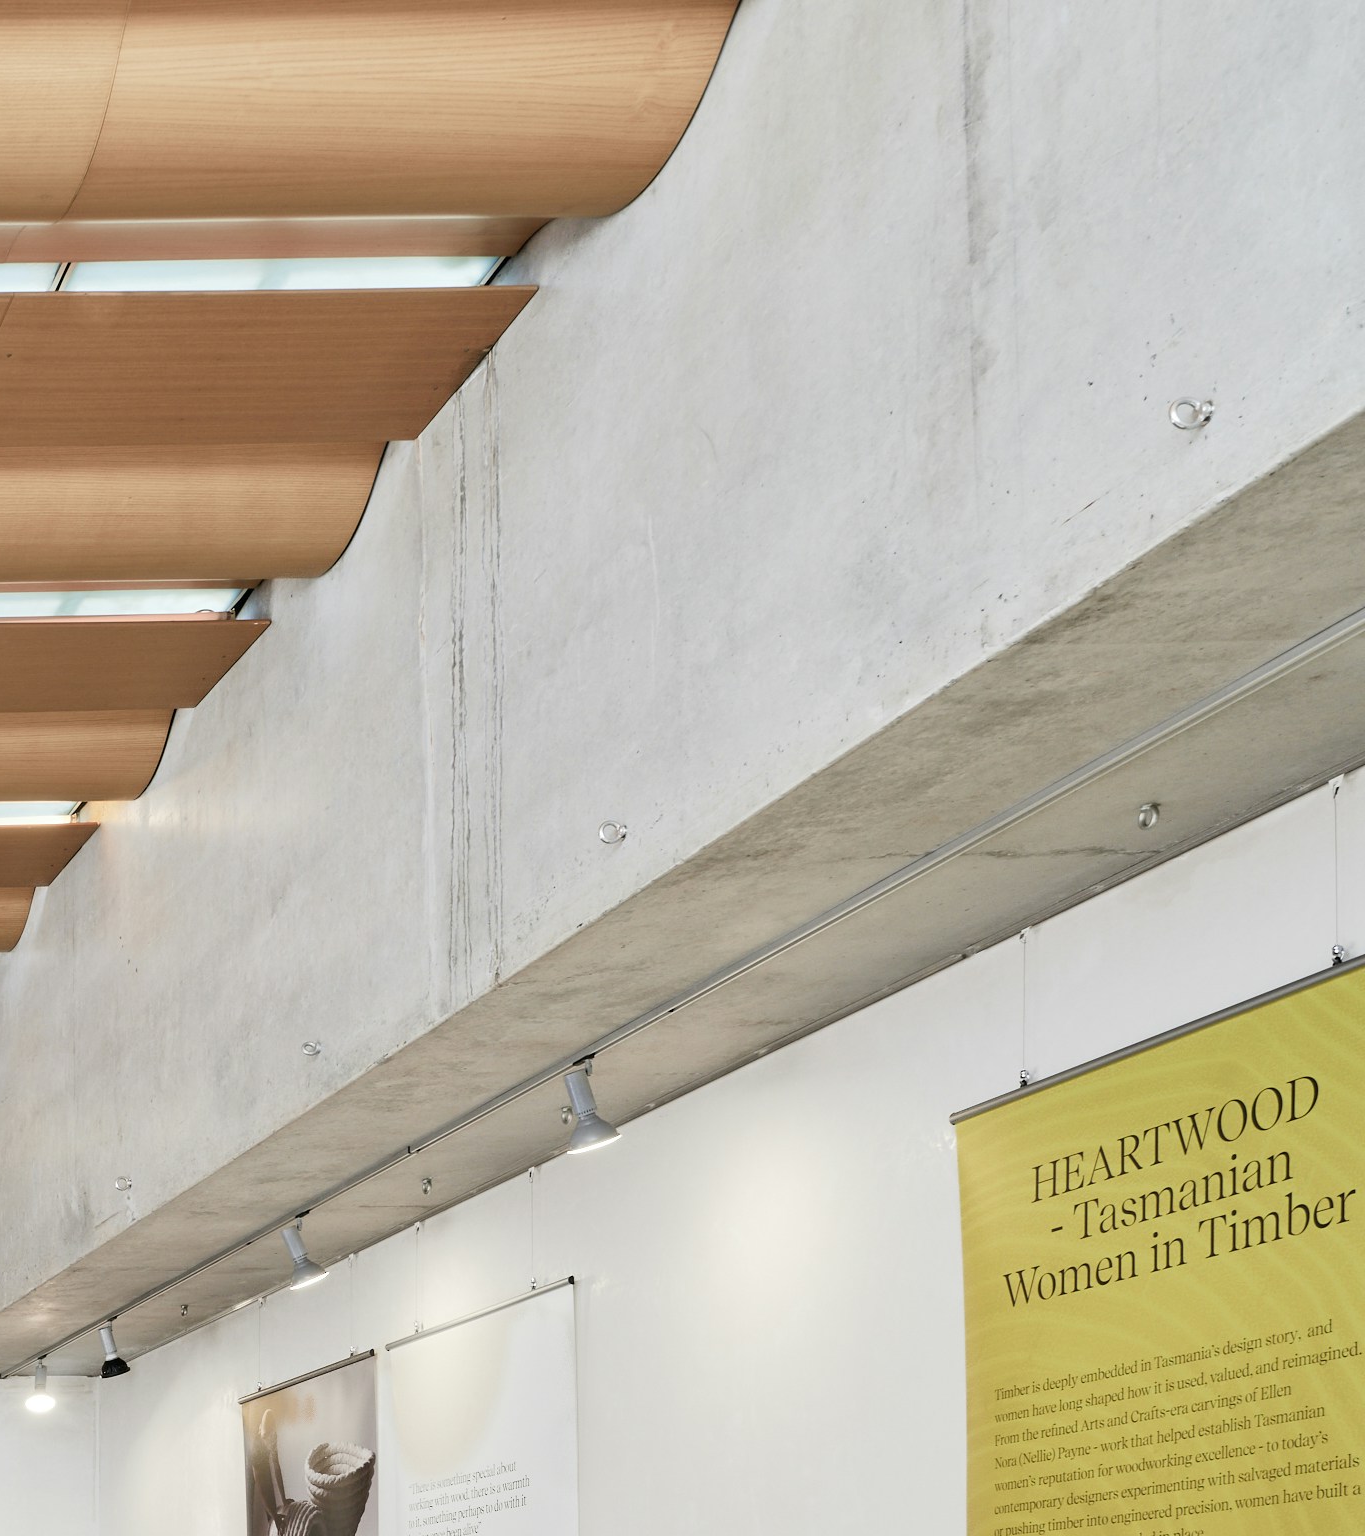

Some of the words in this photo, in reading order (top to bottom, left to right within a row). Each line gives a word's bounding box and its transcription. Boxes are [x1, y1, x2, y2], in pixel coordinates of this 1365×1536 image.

[1032, 1075, 1319, 1203] HEARTWOOD
[1074, 1151, 1293, 1240] Tasmanian
[1003, 1248, 1138, 1308] Women
[1150, 1232, 1186, 1272] in
[1198, 1188, 1356, 1259] Timber
[994, 1384, 1029, 1400] Timber
[1032, 1381, 1040, 1392] is
[1042, 1373, 1078, 1390] deeply
[1080, 1360, 1137, 1383] embedded
[1141, 1359, 1151, 1371] in
[1222, 1337, 1262, 1354] design
[1307, 1318, 1332, 1337] and
[994, 1456, 1016, 1469] Nora
[1018, 1448, 1055, 1466] (Nellie)
[1058, 1446, 1091, 1459] Payne
[1100, 1436, 1128, 1451] work
[1130, 1434, 1153, 1447] that
[1157, 1424, 1195, 1443] helped
[1197, 1416, 1251, 1436] establish
[1253, 1405, 1325, 1427] Tasmanian
[995, 1434, 1019, 1446] From
[1022, 1428, 1038, 1441] the
[1041, 1420, 1077, 1438] refined
[1081, 1419, 1104, 1431] Arts
[1107, 1411, 1127, 1427] and
[1130, 1405, 1188, 1422] Crafts-era
[1191, 1394, 1242, 1412] carvings
[1245, 1386, 1257, 1402] of
[1261, 1384, 1291, 1400] Ellen
[994, 1497, 1064, 1514] contemporary
[1066, 1490, 1118, 1505] designers
[1121, 1476, 1205, 1499] experimenting
[1207, 1470, 1235, 1485] with
[1238, 1461, 1291, 1482] salvaged
[1294, 1453, 1359, 1474] materials
[1038, 1467, 1094, 1486] reputation
[1097, 1463, 1113, 1476] for
[1115, 1453, 1192, 1473] woodworking
[1195, 1445, 1255, 1462] excellence
[1266, 1441, 1279, 1452] to
